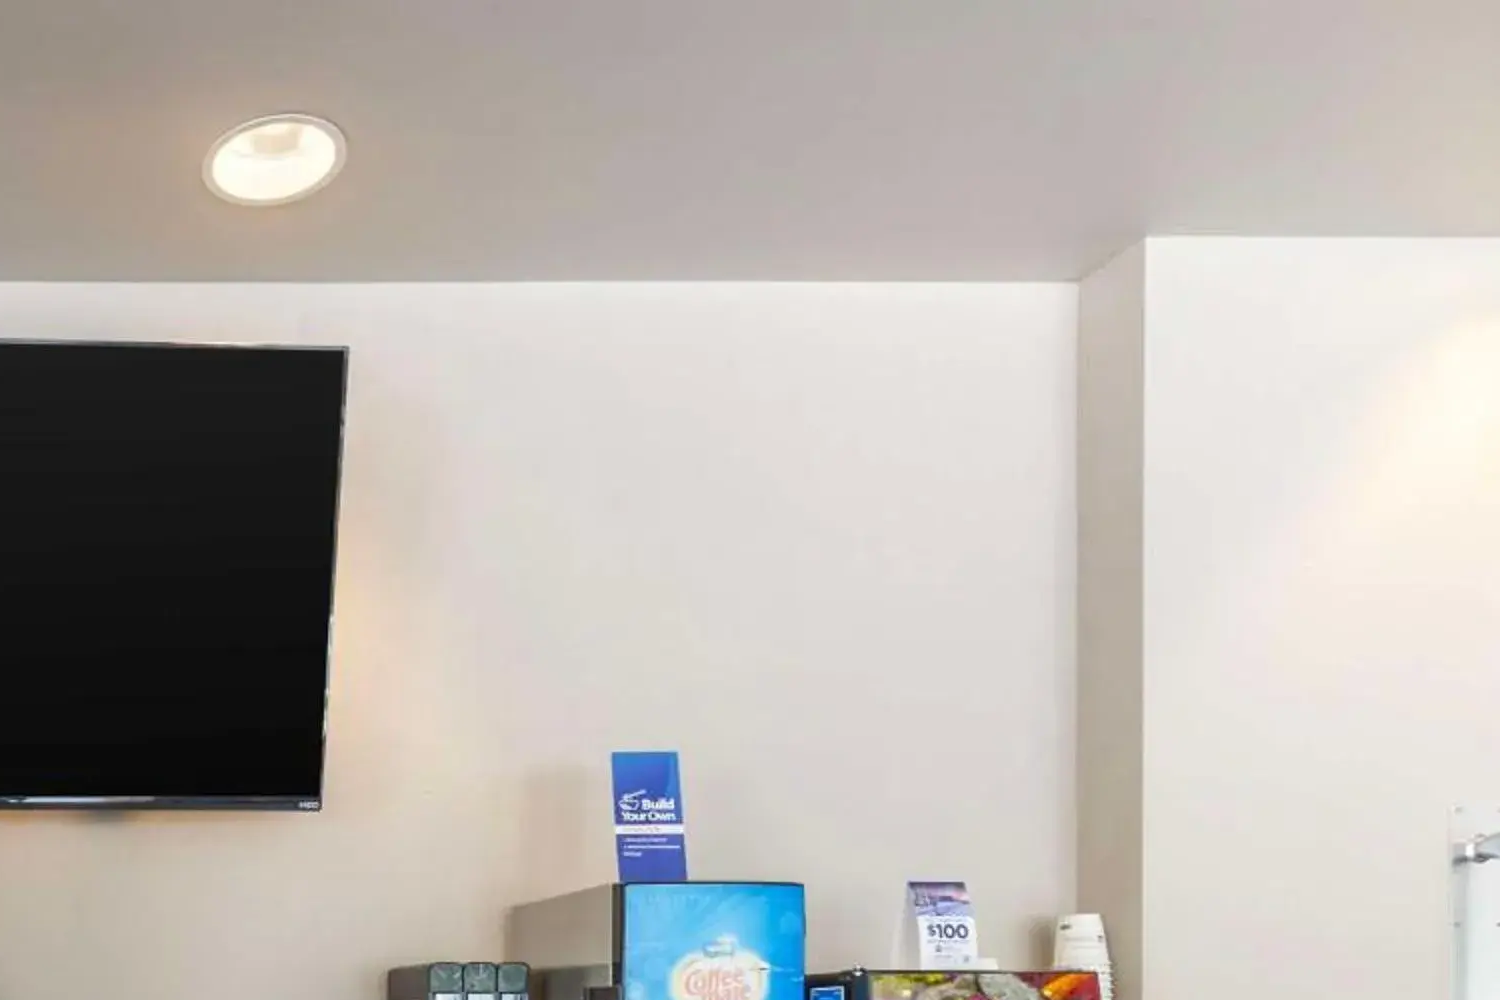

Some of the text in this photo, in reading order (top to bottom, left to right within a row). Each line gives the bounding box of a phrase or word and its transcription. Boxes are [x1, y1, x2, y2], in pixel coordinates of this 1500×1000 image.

[641, 798, 675, 810] Build
[621, 811, 677, 821] Your Own
[927, 923, 969, 939] $100
[685, 961, 745, 997] Coffee
